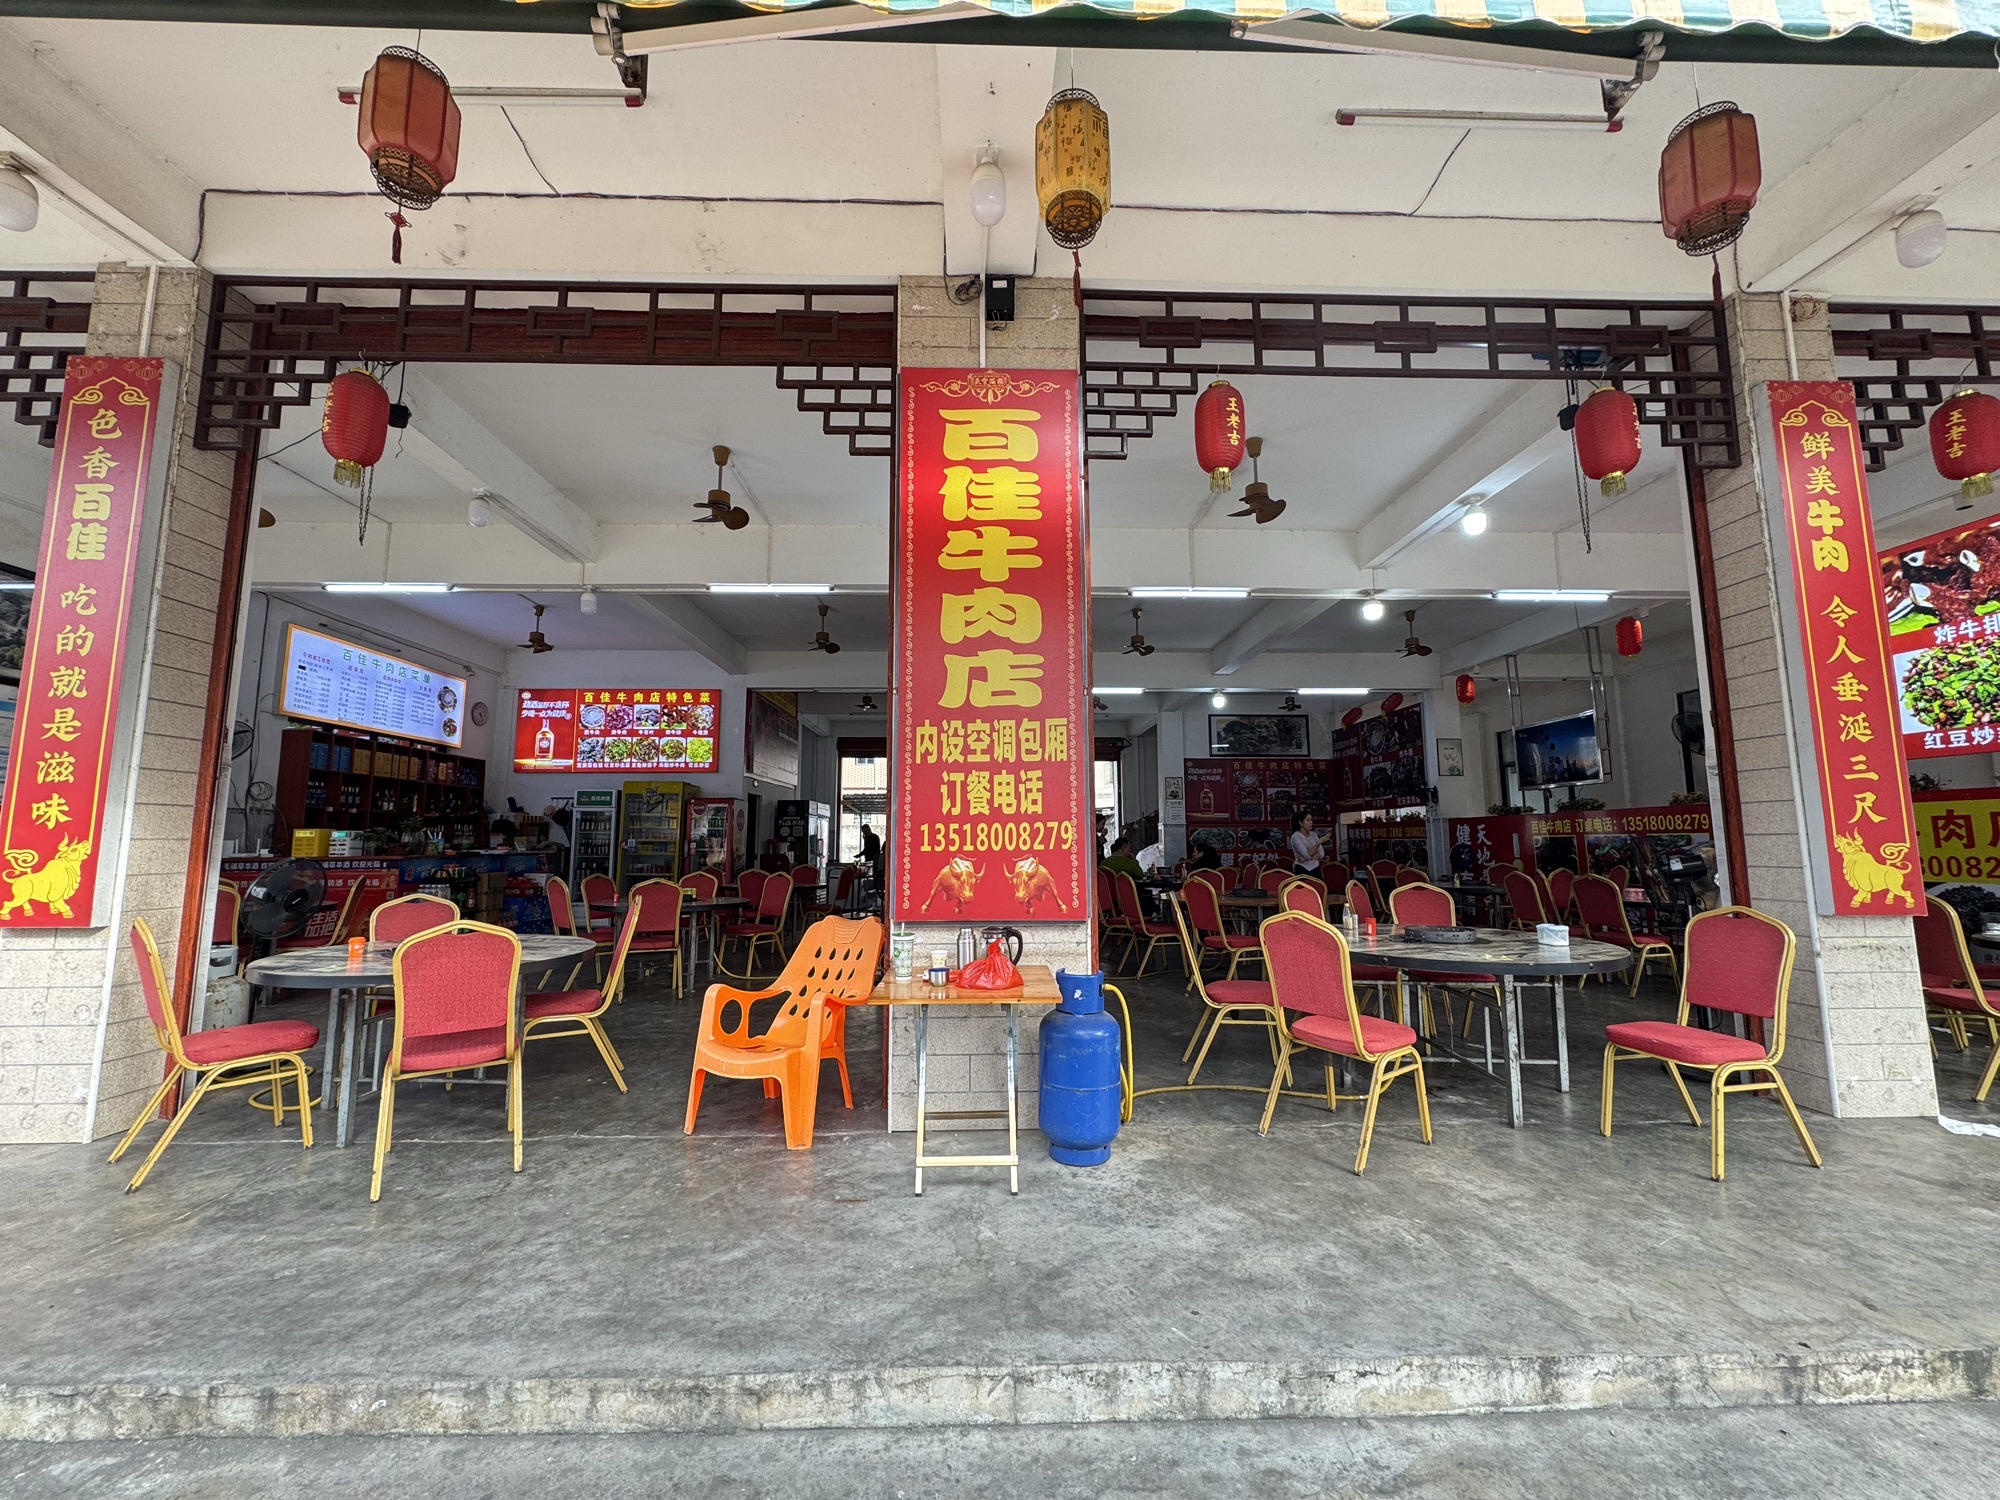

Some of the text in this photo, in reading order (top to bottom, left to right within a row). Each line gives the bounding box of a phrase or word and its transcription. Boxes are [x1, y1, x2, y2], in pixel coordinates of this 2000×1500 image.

[1226, 397, 1241, 446] 王老吉
[1944, 408, 1968, 459] 王老吉
[938, 406, 1045, 709] 百佳牛肉店
[30, 407, 122, 833] 色香百佳 吃的就是滋味
[1800, 431, 1889, 824] 鲜美牛肉 令人垂涎三尺
[1934, 613, 2000, 645] 炸牛排
[342, 648, 432, 685] 百佳牛肉店菜单
[583, 691, 712, 704] 百佳牛肉店特色菜
[915, 717, 1069, 765] 内设空调包厢
[1923, 725, 2000, 750] 红豆炒
[1232, 760, 1328, 771] 百佳牛肉店特色菜
[940, 769, 1044, 816] 订餐电话
[919, 819, 1073, 853] 13518008279
[1531, 818, 1571, 834] 百佳牛肉店
[1621, 813, 1710, 832] 13518008279
[319, 860, 351, 869] 铺草本酒
[347, 878, 380, 887] 欢光临
[306, 910, 339, 925] 生活
